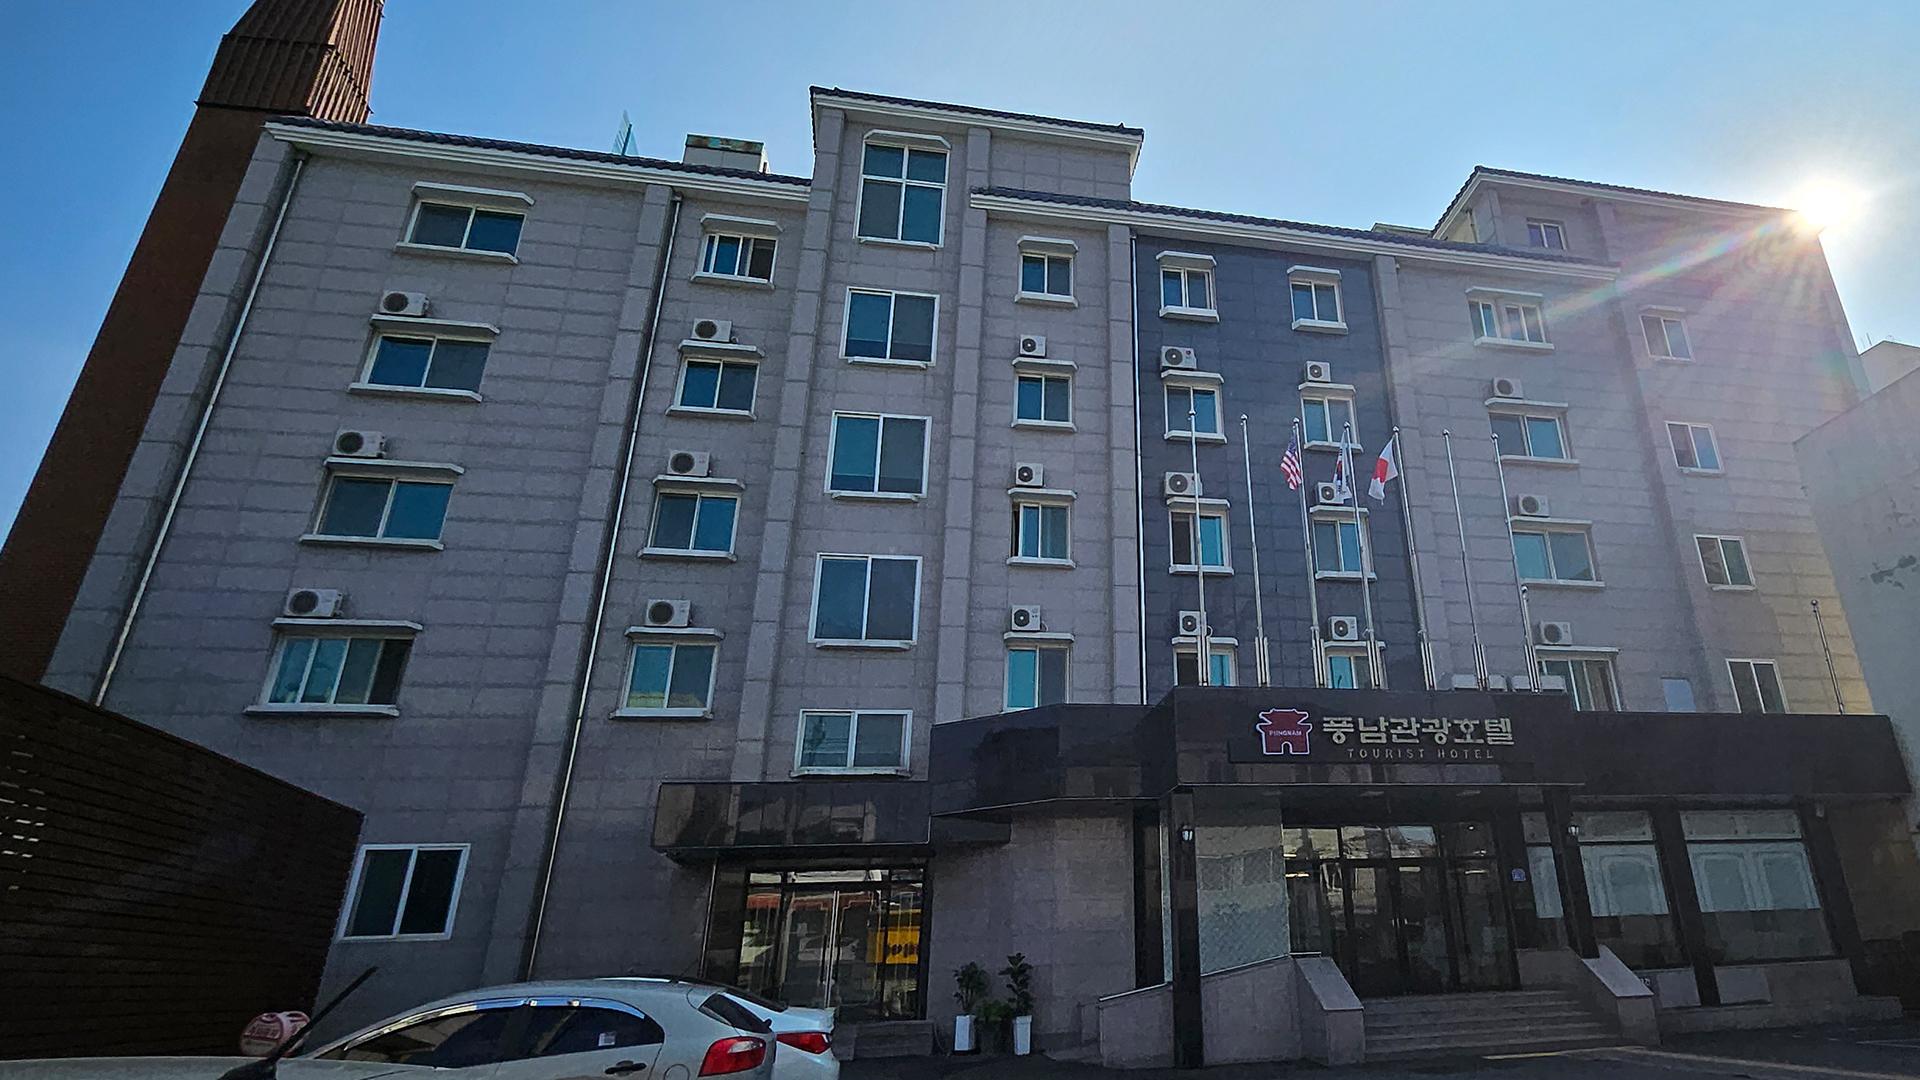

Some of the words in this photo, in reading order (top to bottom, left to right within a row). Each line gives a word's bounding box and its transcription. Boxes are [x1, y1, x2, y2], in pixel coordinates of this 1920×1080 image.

[1323, 716, 1514, 745] 풍남관광호텔
[1347, 748, 1425, 759] TOURIST
[1437, 748, 1494, 759] HOTEL
